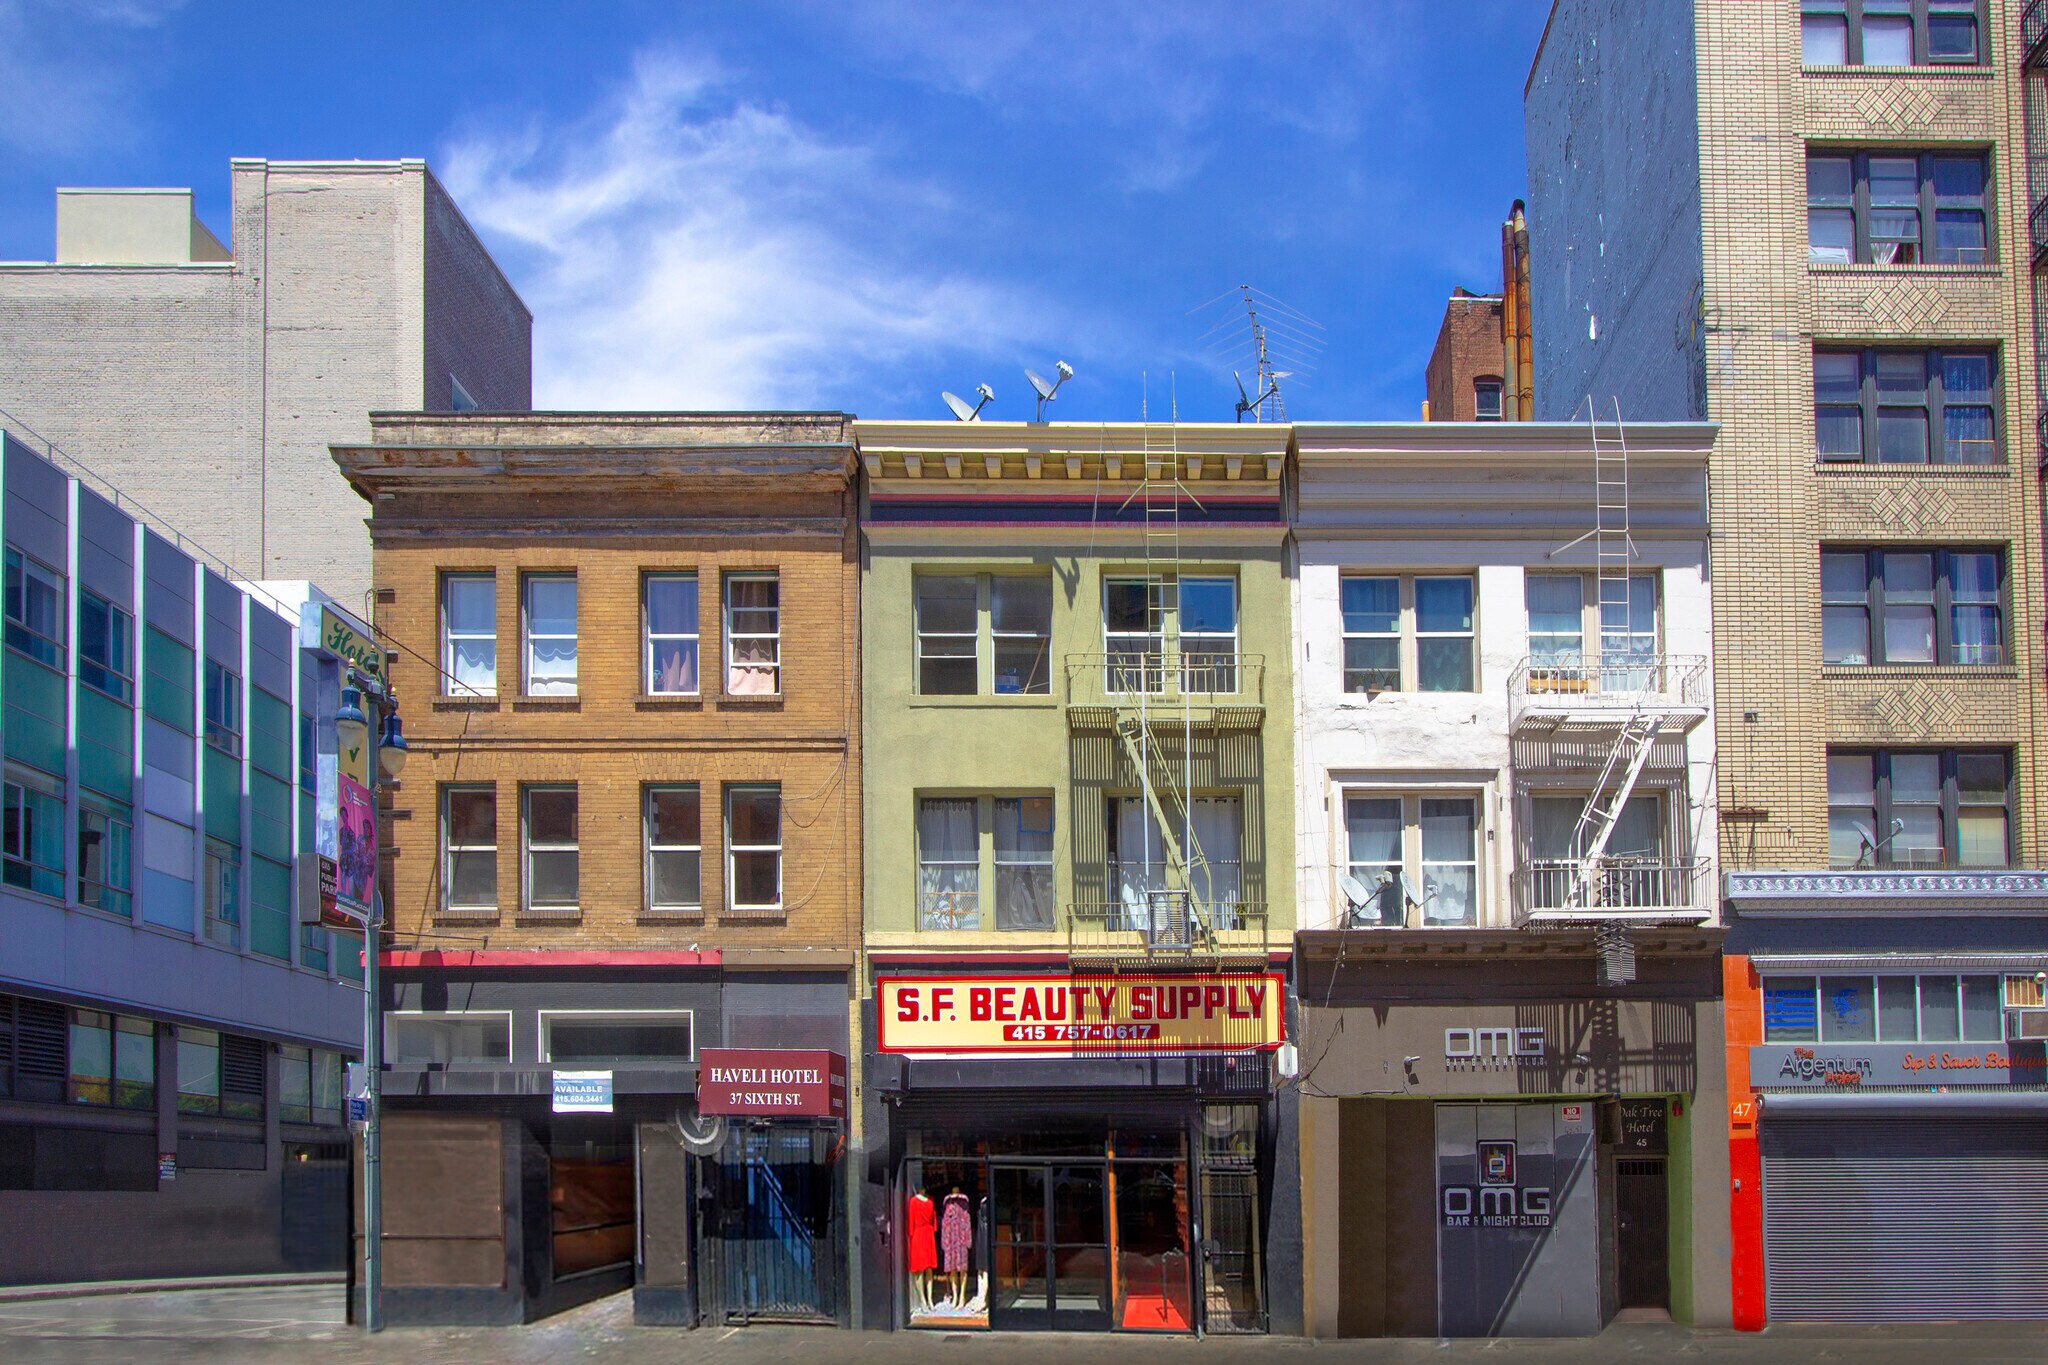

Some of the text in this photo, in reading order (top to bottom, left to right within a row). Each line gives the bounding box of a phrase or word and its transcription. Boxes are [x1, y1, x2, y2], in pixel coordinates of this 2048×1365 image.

[327, 622, 384, 684] Hote
[896, 985, 1267, 1022] S.F. BEAUTY SUPPLY
[1012, 1025, 1151, 1040] 415 757-0617
[1444, 1027, 1544, 1056] OMG
[1793, 1047, 1814, 1059] The
[1779, 1054, 1872, 1075] Argentum
[1902, 1052, 1925, 1073] Sip
[1927, 1053, 1937, 1068] &
[1941, 1052, 1982, 1069] Savor
[710, 1067, 767, 1084] HAVELI
[770, 1069, 823, 1084] HOTEL
[554, 1085, 603, 1093] AVAILABLE
[554, 1095, 603, 1103] 415.604.3441
[729, 1092, 803, 1106] 37 SIXTH ST.
[1566, 1107, 1577, 1115] NO
[1639, 1105, 1663, 1117] Tree
[1733, 1103, 1751, 1117] 47
[1626, 1120, 1656, 1133] Hotel
[1636, 1138, 1647, 1147] 45
[1444, 1187, 1550, 1215] OMG
[1447, 1216, 1470, 1226] BAR
[1473, 1216, 1479, 1226] &
